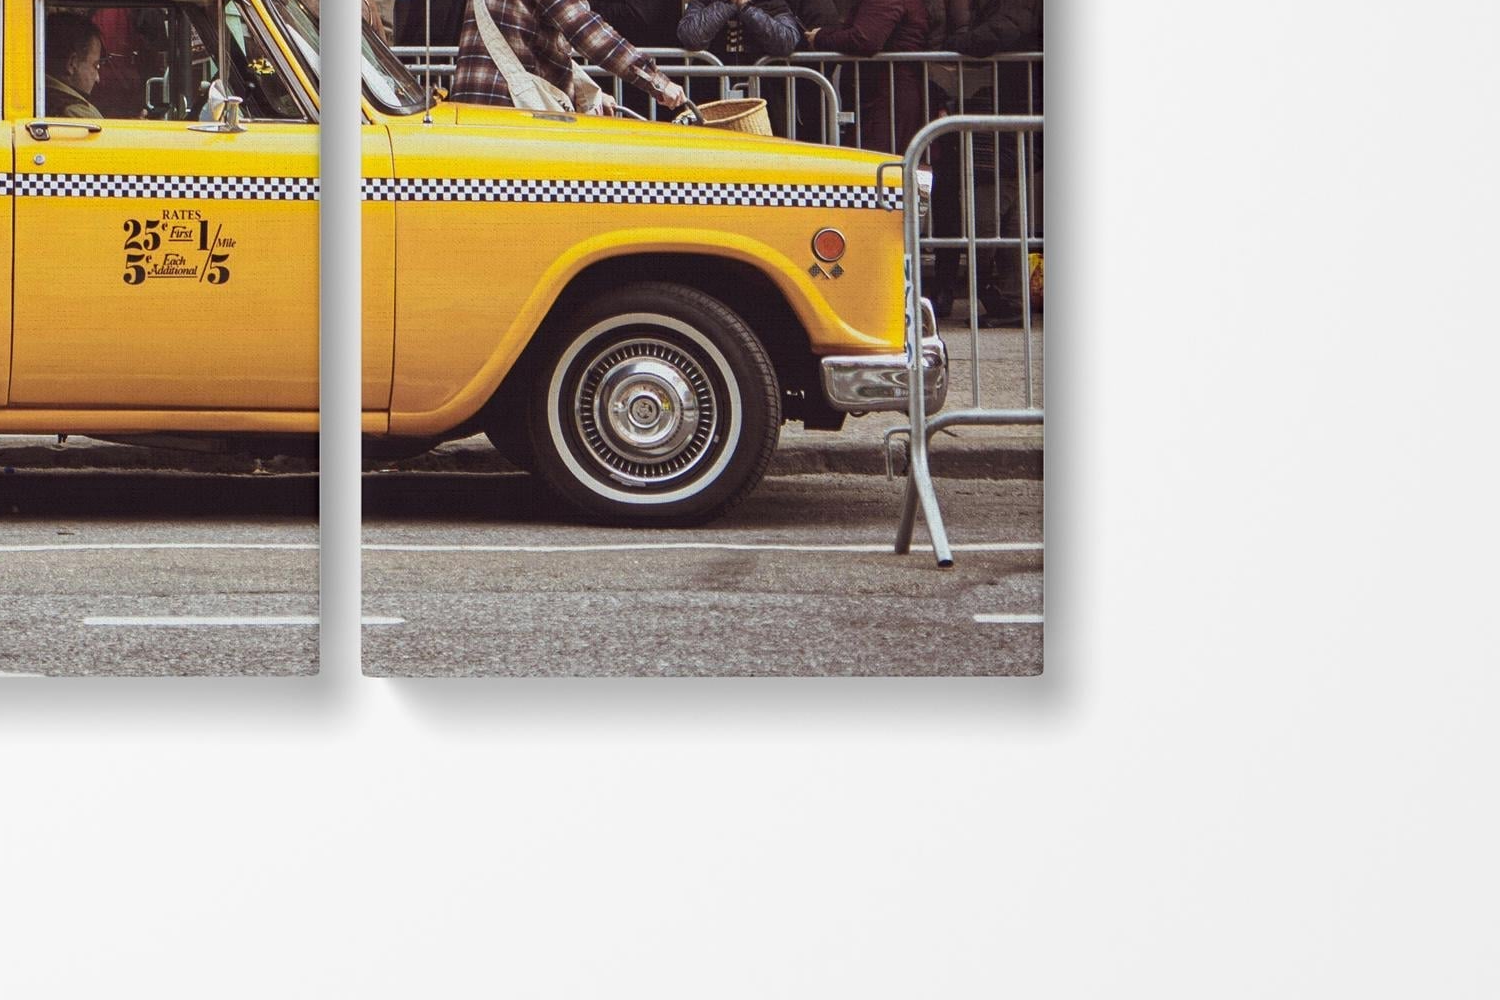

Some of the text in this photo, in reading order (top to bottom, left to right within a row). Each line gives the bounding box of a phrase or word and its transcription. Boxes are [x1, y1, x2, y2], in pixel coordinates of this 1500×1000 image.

[162, 209, 202, 220] RATES
[169, 226, 194, 239] First
[216, 238, 237, 249] Mile
[163, 253, 186, 267] Each
[147, 265, 199, 276] Additional
